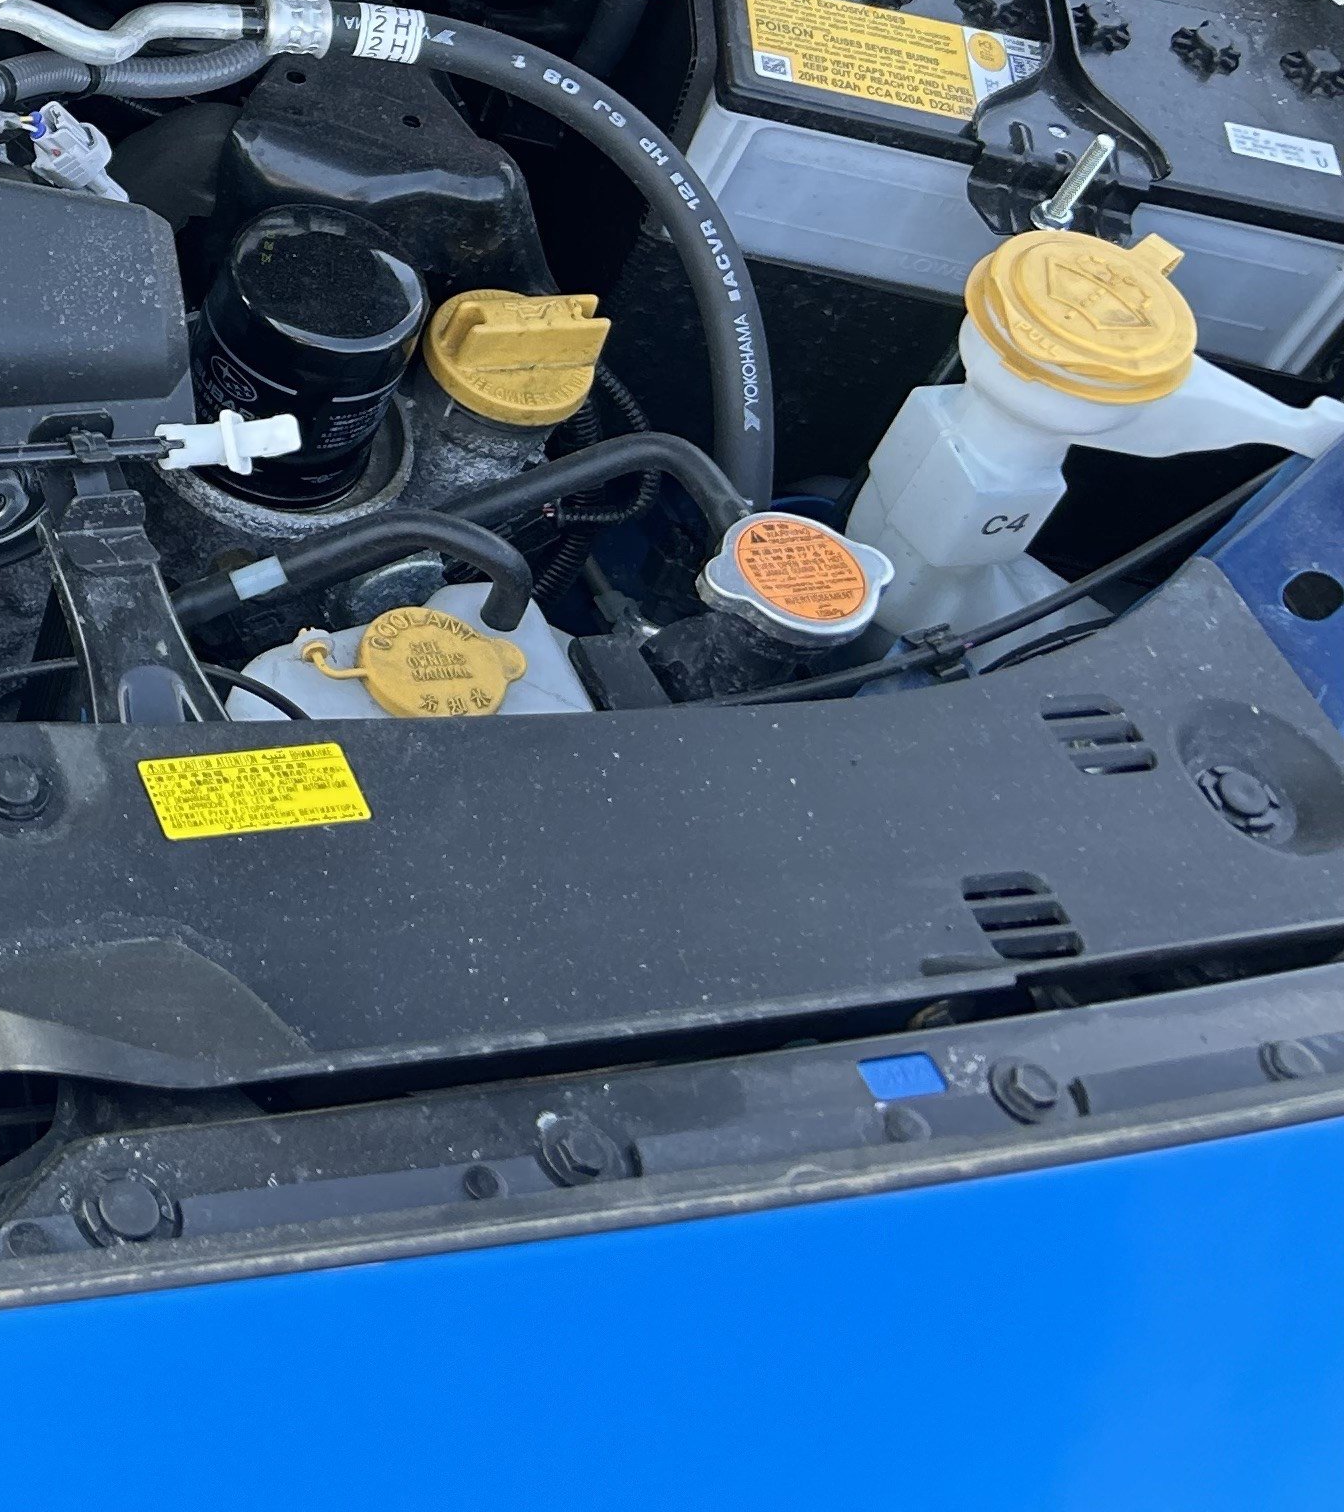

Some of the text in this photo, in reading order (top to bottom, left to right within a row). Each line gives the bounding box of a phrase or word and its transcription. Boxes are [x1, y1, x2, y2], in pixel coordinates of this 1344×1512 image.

[816, 0, 869, 17] EXPLOSIVE
[755, 18, 814, 40] POISON
[822, 33, 863, 49] CAUSES
[864, 42, 903, 57] SEVERE
[905, 51, 940, 66] BURNS
[798, 70, 829, 87] 20HR
[866, 85, 893, 99] CCA
[895, 91, 925, 107] 620A
[801, 52, 828, 63] KEEP
[829, 59, 855, 71] VENT
[858, 64, 885, 77] CAPS
[918, 78, 939, 89] AND
[802, 61, 829, 72] KEEP
[832, 68, 852, 79] OUT
[854, 72, 867, 81] OF
[870, 75, 904, 90] REACH
[907, 83, 920, 92] OF
[639, 137, 669, 166] HP
[1014, 320, 1059, 357] PULL
[738, 314, 761, 406] YOKOHAMA
[981, 513, 1030, 535] C4
[370, 611, 479, 650] COOLANT
